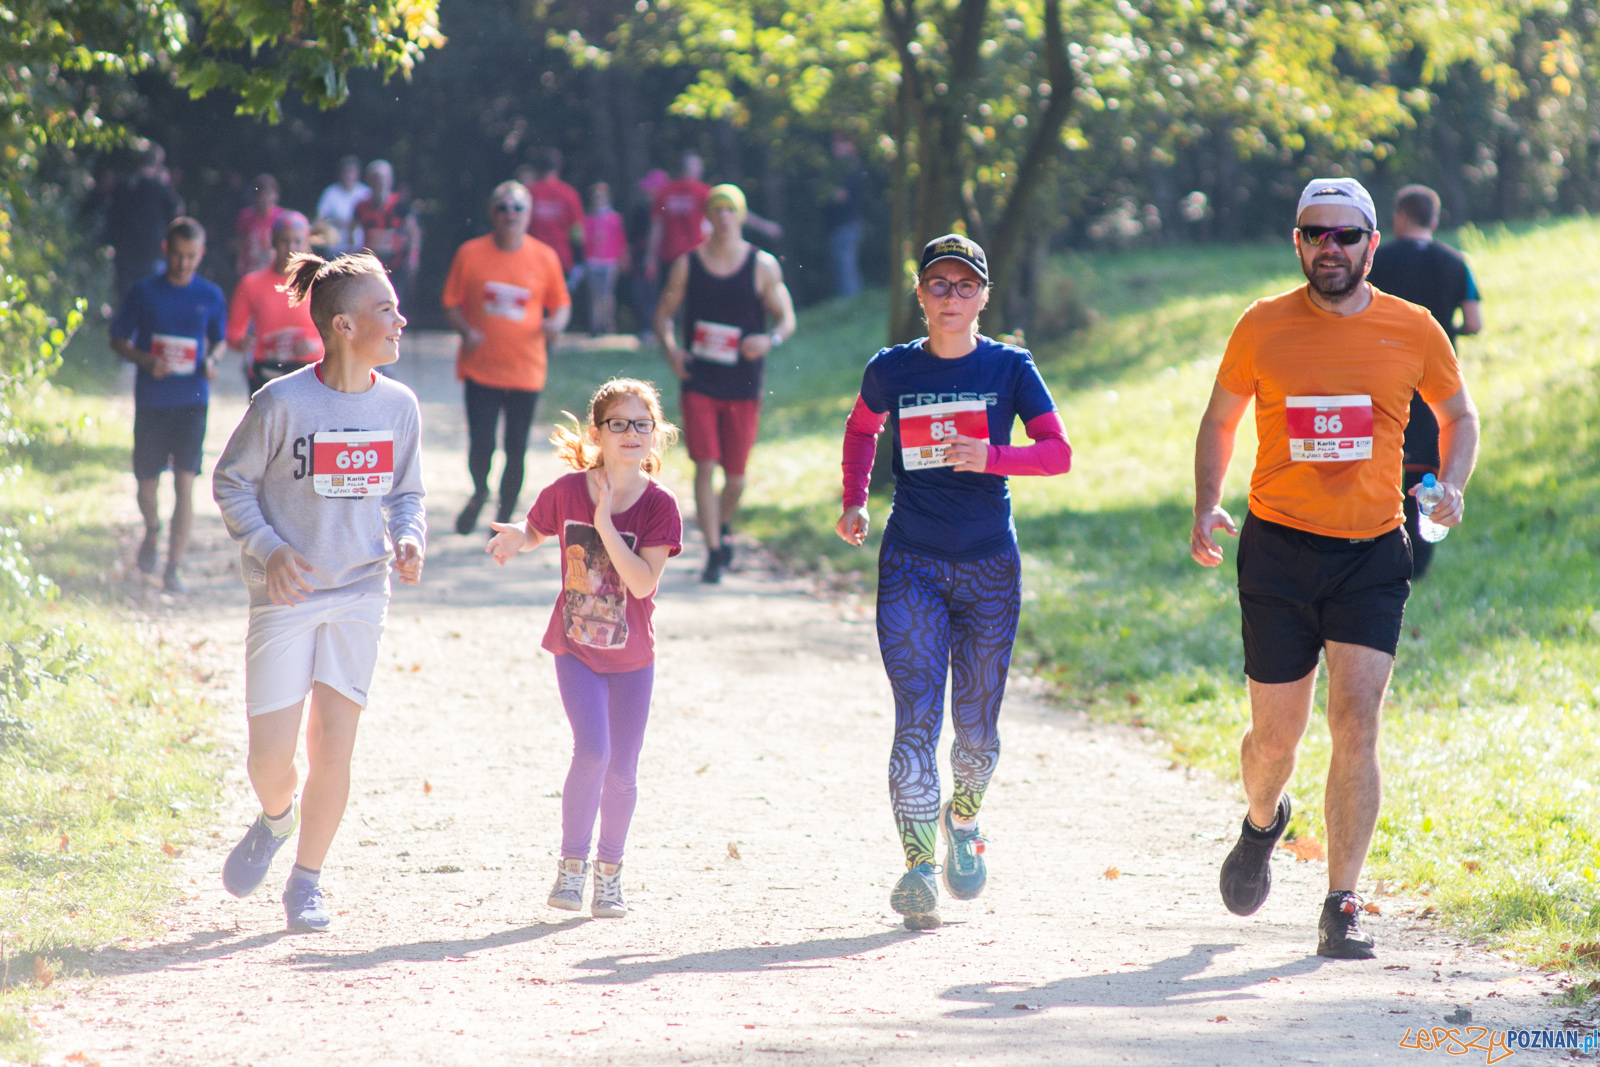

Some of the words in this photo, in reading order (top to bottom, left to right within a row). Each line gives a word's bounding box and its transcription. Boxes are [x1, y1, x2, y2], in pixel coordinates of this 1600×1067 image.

[898, 391, 998, 408] CROSS
[930, 420, 958, 440] 85
[1314, 414, 1343, 434] 86
[336, 449, 379, 469] 699
